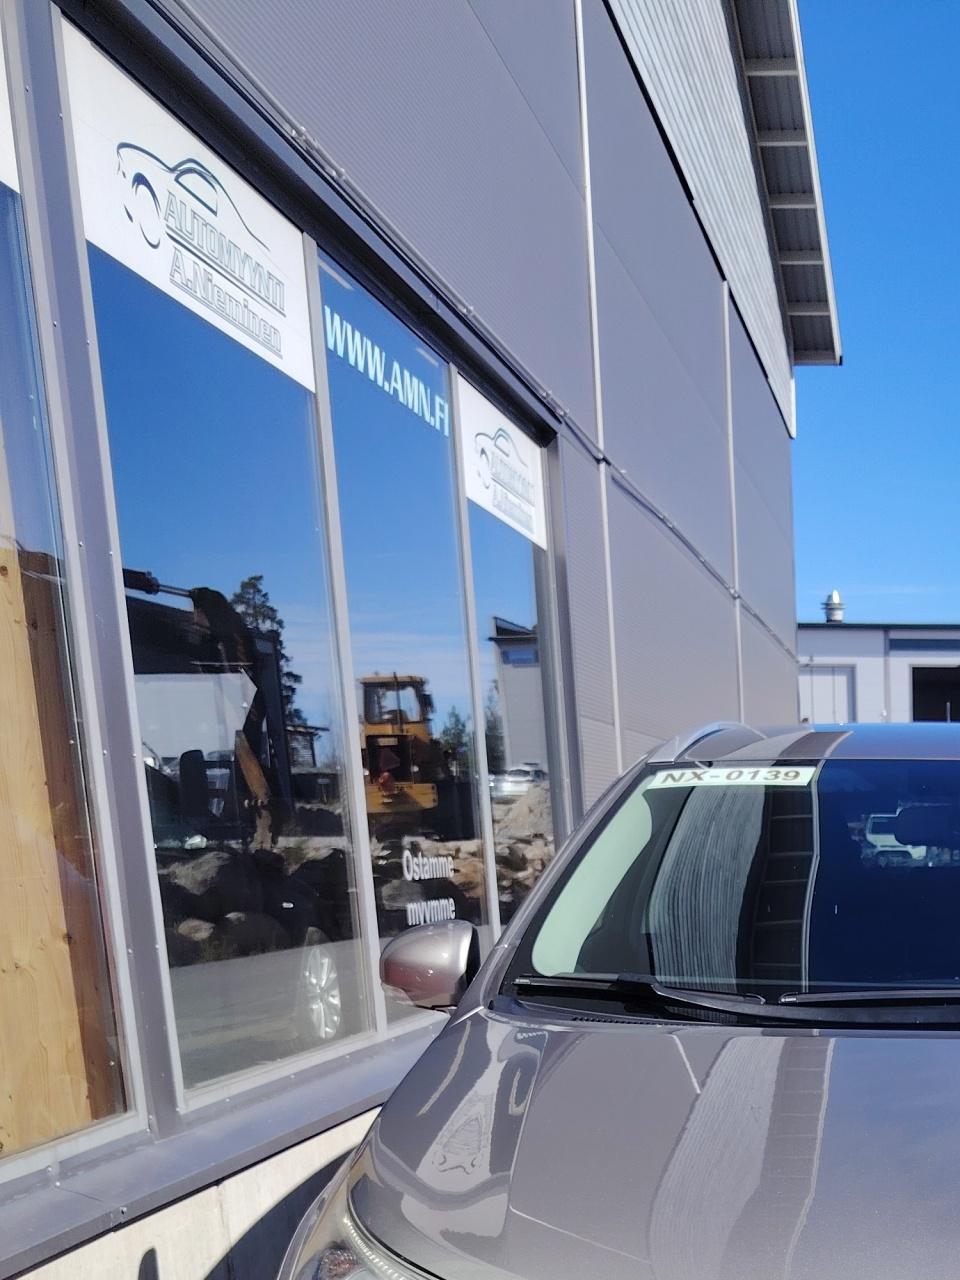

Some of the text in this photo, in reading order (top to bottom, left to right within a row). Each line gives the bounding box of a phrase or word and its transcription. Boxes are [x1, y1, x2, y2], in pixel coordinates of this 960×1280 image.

[164, 190, 284, 313] AUTOMYYNTI
[169, 247, 283, 354] A.Nieminen
[324, 305, 449, 437] WWW.AMN.FI
[660, 770, 801, 784] NX-0139
[403, 850, 455, 881] Ostamme
